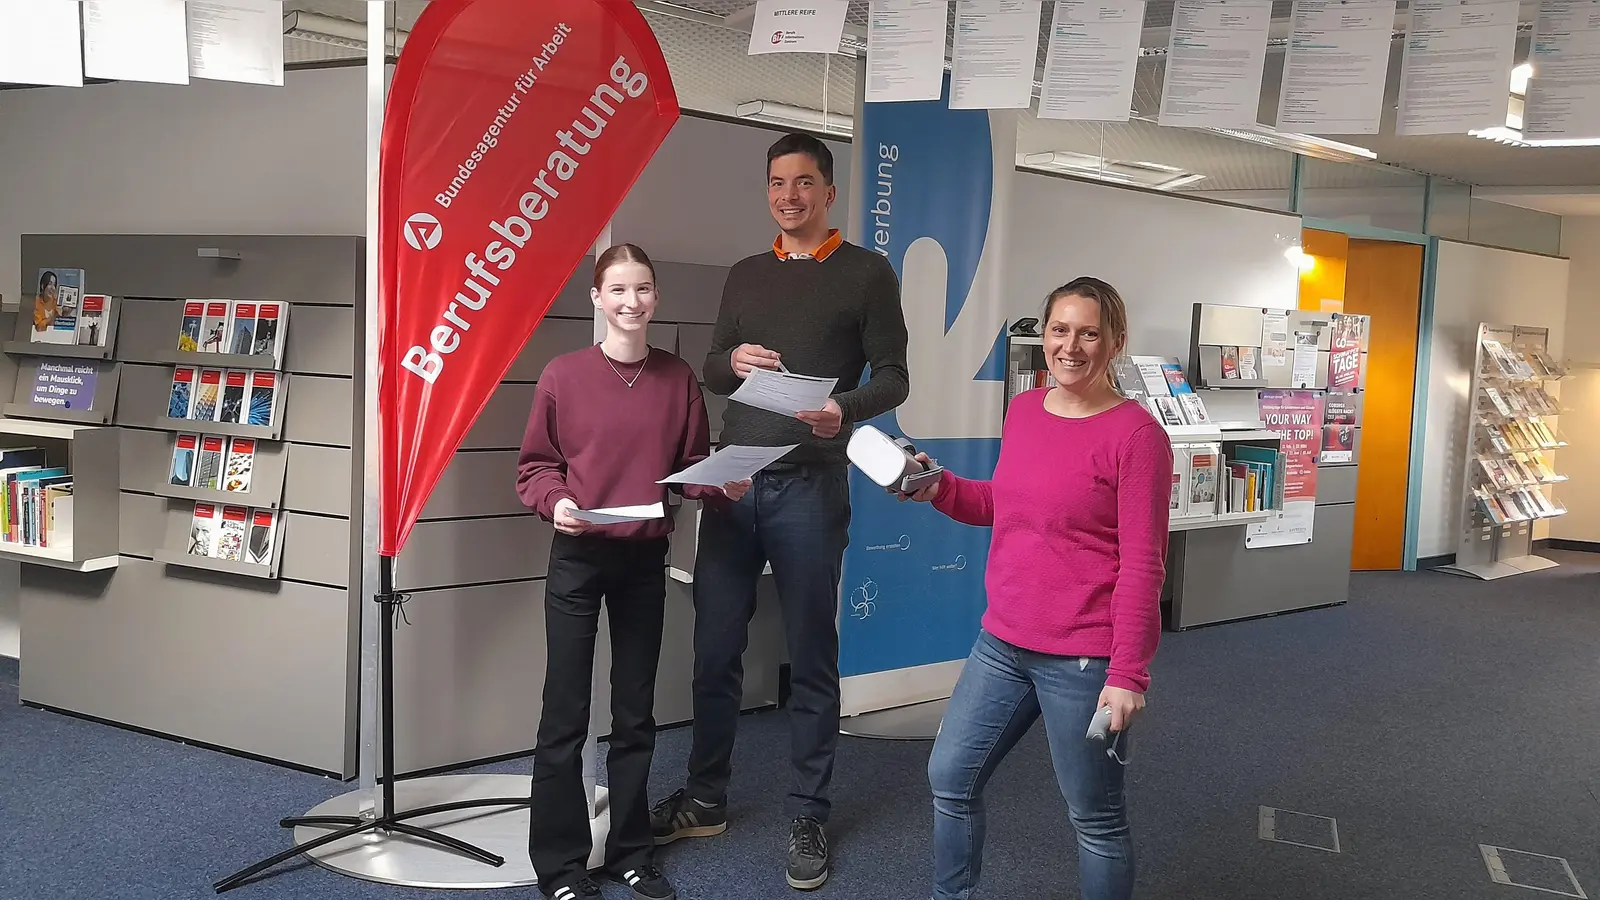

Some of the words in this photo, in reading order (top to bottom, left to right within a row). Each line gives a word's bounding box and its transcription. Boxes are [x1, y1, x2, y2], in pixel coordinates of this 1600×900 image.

[435, 92, 522, 209] Bundesagentur
[514, 69, 538, 96] für
[532, 22, 572, 72] Arbeit
[400, 55, 648, 385] Berufsberatung
[40, 362, 74, 373] Manchmal
[74, 366, 94, 375] reicht
[1333, 353, 1359, 375] TAGE
[50, 374, 84, 386] Mausklick,
[48, 384, 69, 395] Dinge
[33, 394, 66, 406] bewegen.
[1265, 413, 1289, 425] YOUR
[1292, 413, 1312, 425] WAY
[1276, 429, 1292, 441] THE
[1293, 429, 1314, 440] TOP!
